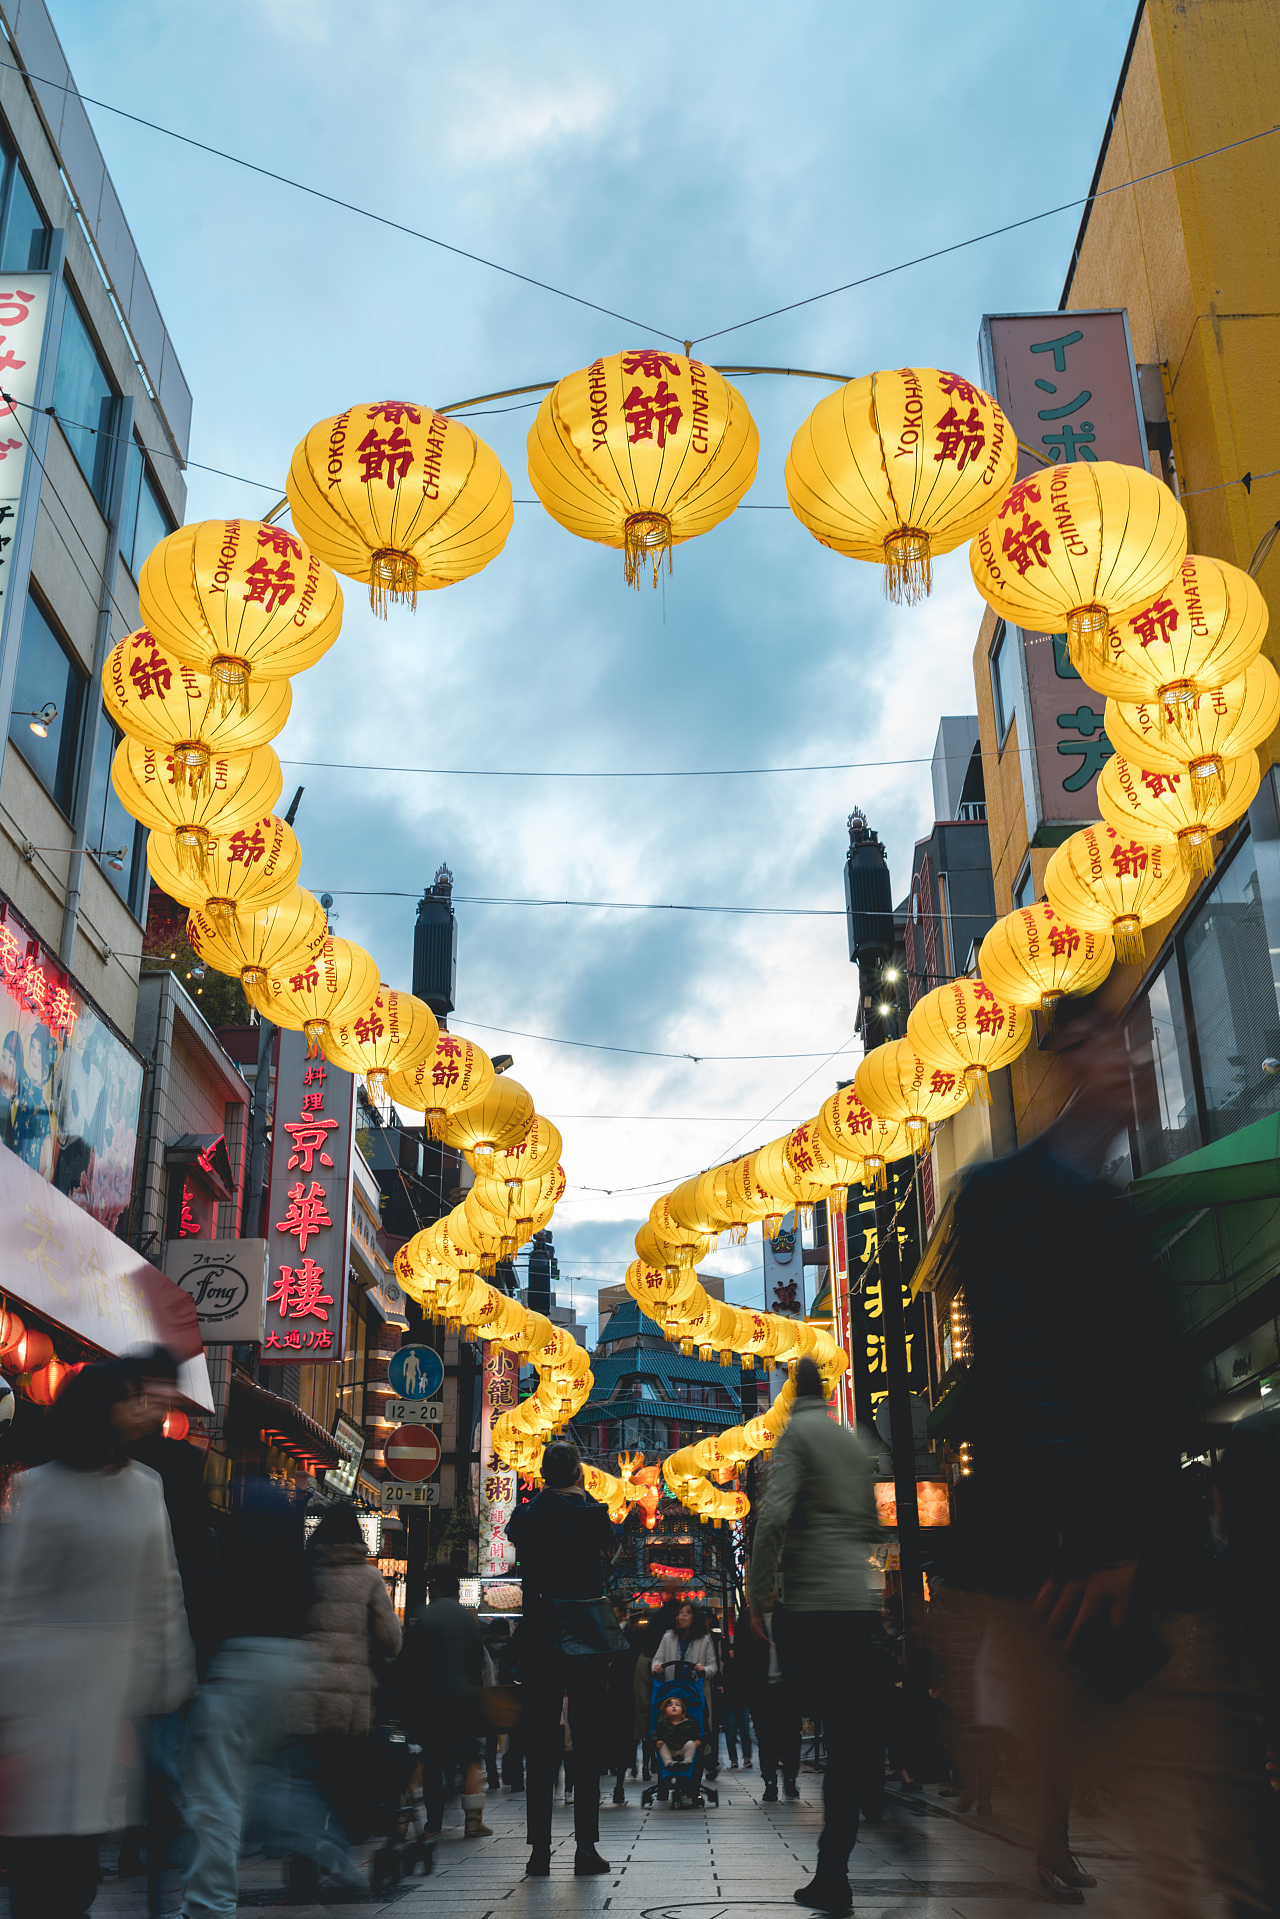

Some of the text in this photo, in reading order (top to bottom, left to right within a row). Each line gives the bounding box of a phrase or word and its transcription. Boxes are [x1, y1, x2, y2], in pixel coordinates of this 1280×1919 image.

[620, 349, 683, 449] 春節
[934, 369, 986, 471] 春節
[355, 400, 421, 490] 春節
[242, 521, 302, 614] 春節
[227, 816, 271, 868] 節
[431, 1036, 462, 1089] 春節
[791, 1123, 814, 1173] 春節
[266, 1112, 339, 1321] 京華樓
[193, 1253, 236, 1265] フォーン
[225, 1311, 240, 1321] TOWN
[264, 1328, 334, 1350] 大通り店
[486, 1561, 508, 1573] 酒家
